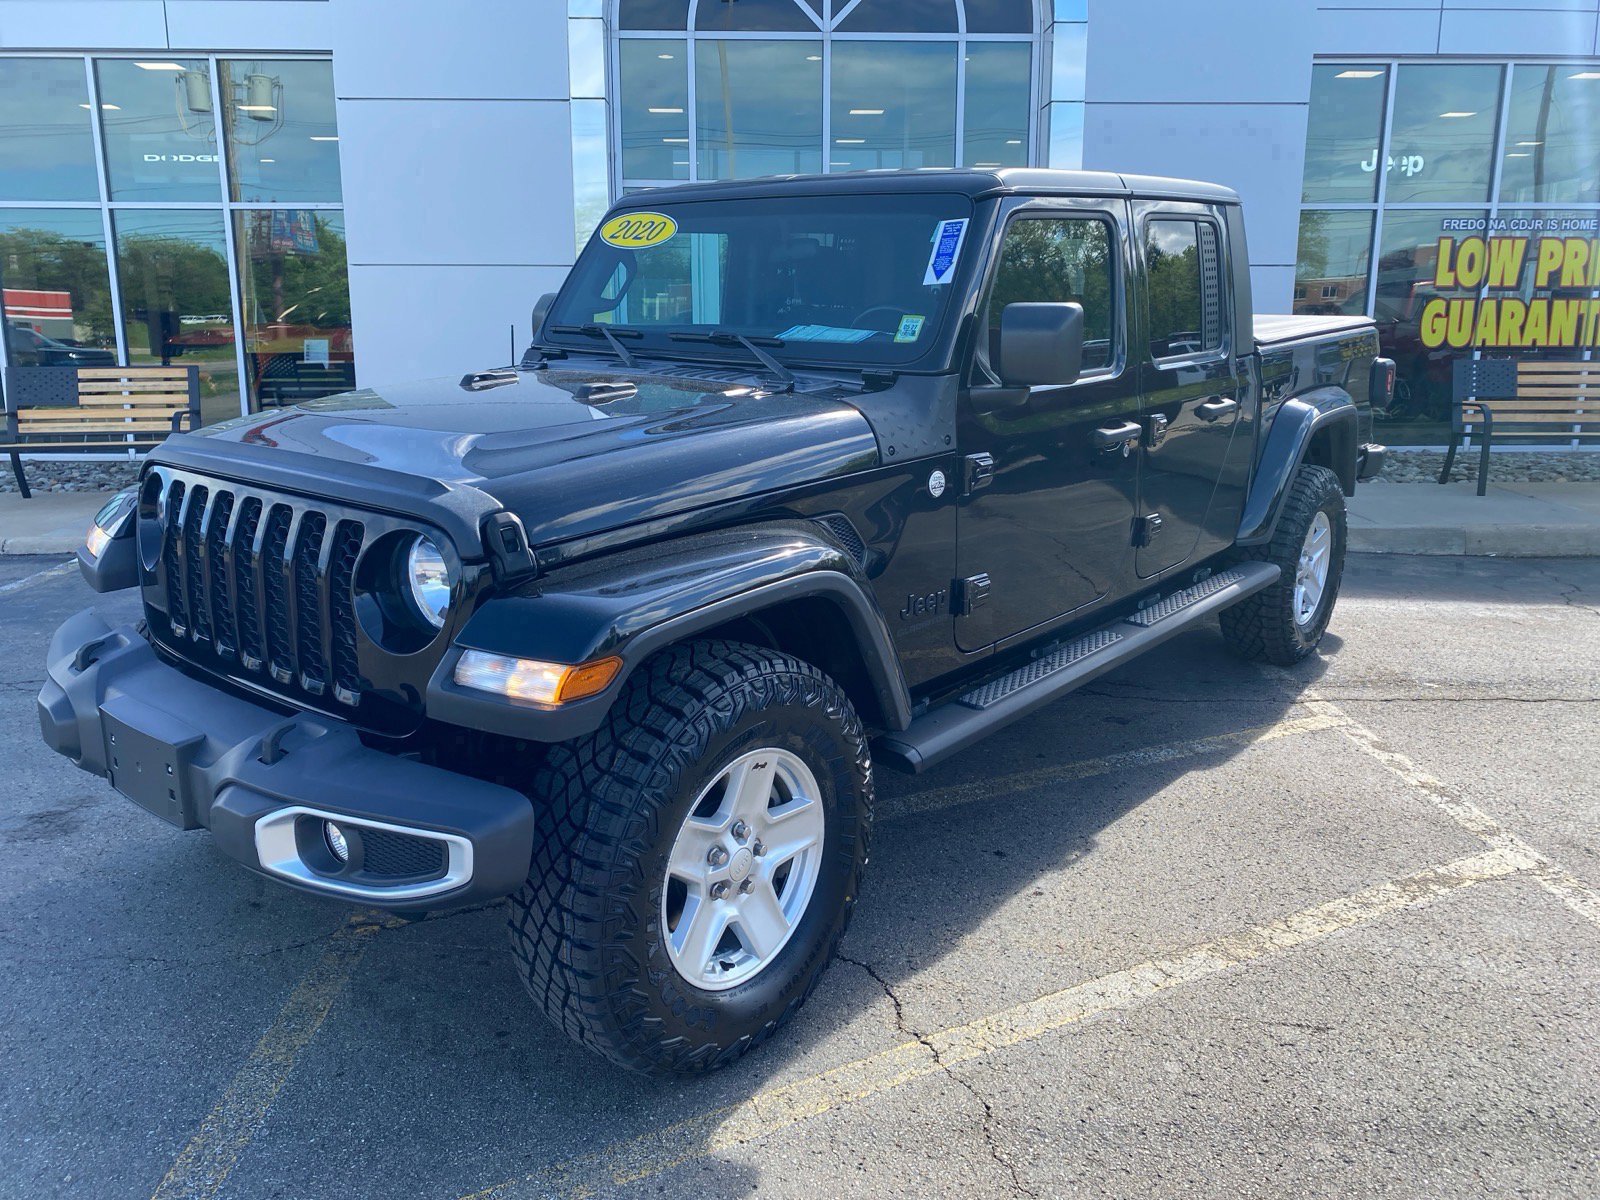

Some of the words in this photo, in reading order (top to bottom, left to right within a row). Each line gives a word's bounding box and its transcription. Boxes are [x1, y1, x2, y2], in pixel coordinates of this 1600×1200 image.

[608, 220, 667, 241] 2020
[1510, 219, 1544, 231] CDJR
[1546, 219, 1558, 231] IS
[1561, 219, 1598, 231] HOME
[1434, 236, 1529, 289] LOW
[1420, 298, 1600, 348] GUARANT
